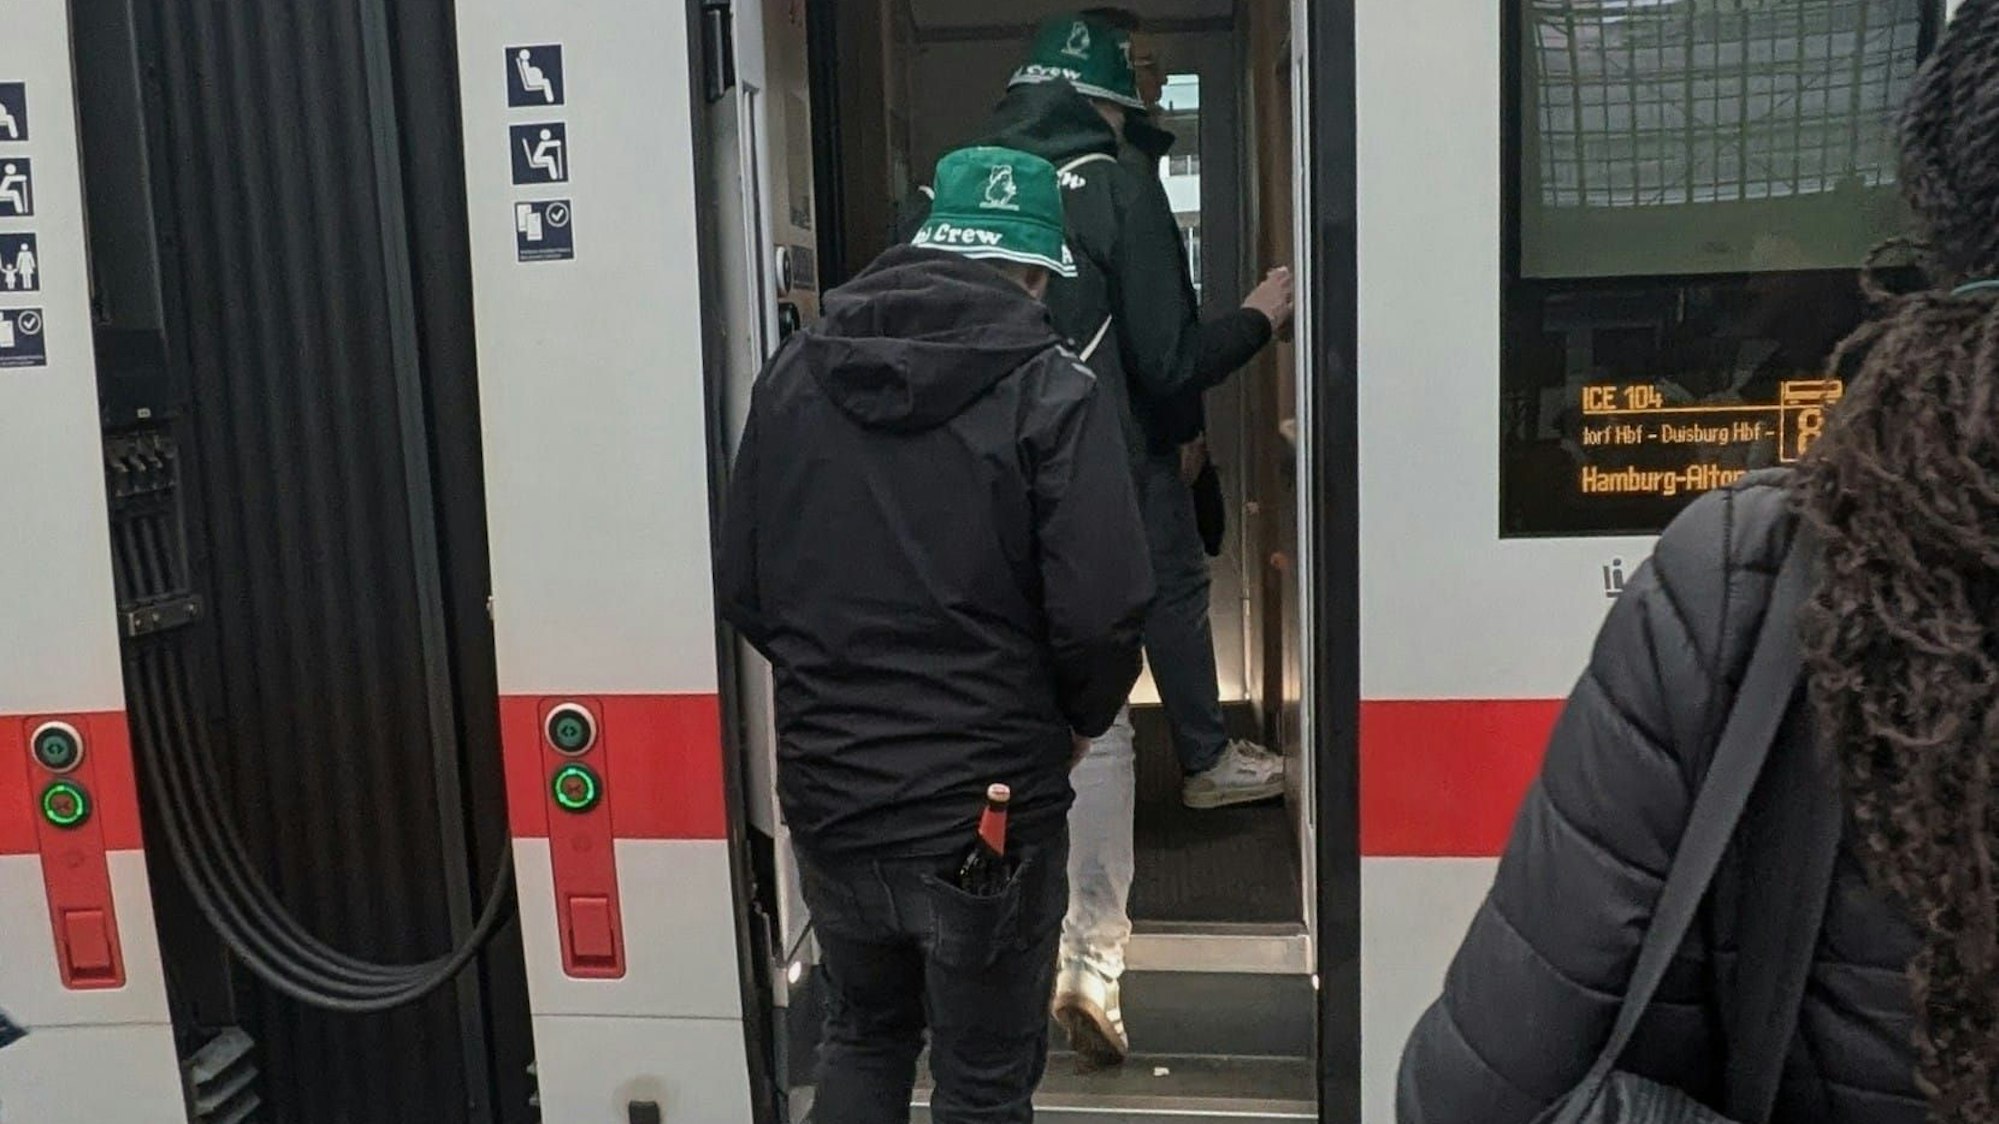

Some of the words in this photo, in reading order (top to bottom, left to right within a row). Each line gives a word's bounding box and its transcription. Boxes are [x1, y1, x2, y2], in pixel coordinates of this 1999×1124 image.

[933, 222, 1003, 245] Crew
[1582, 385, 1617, 410] ICE
[1623, 384, 1663, 409] 104
[1615, 424, 1643, 444] Hbf
[1661, 423, 1729, 445] Duisburg
[1732, 421, 1761, 442] Hbf
